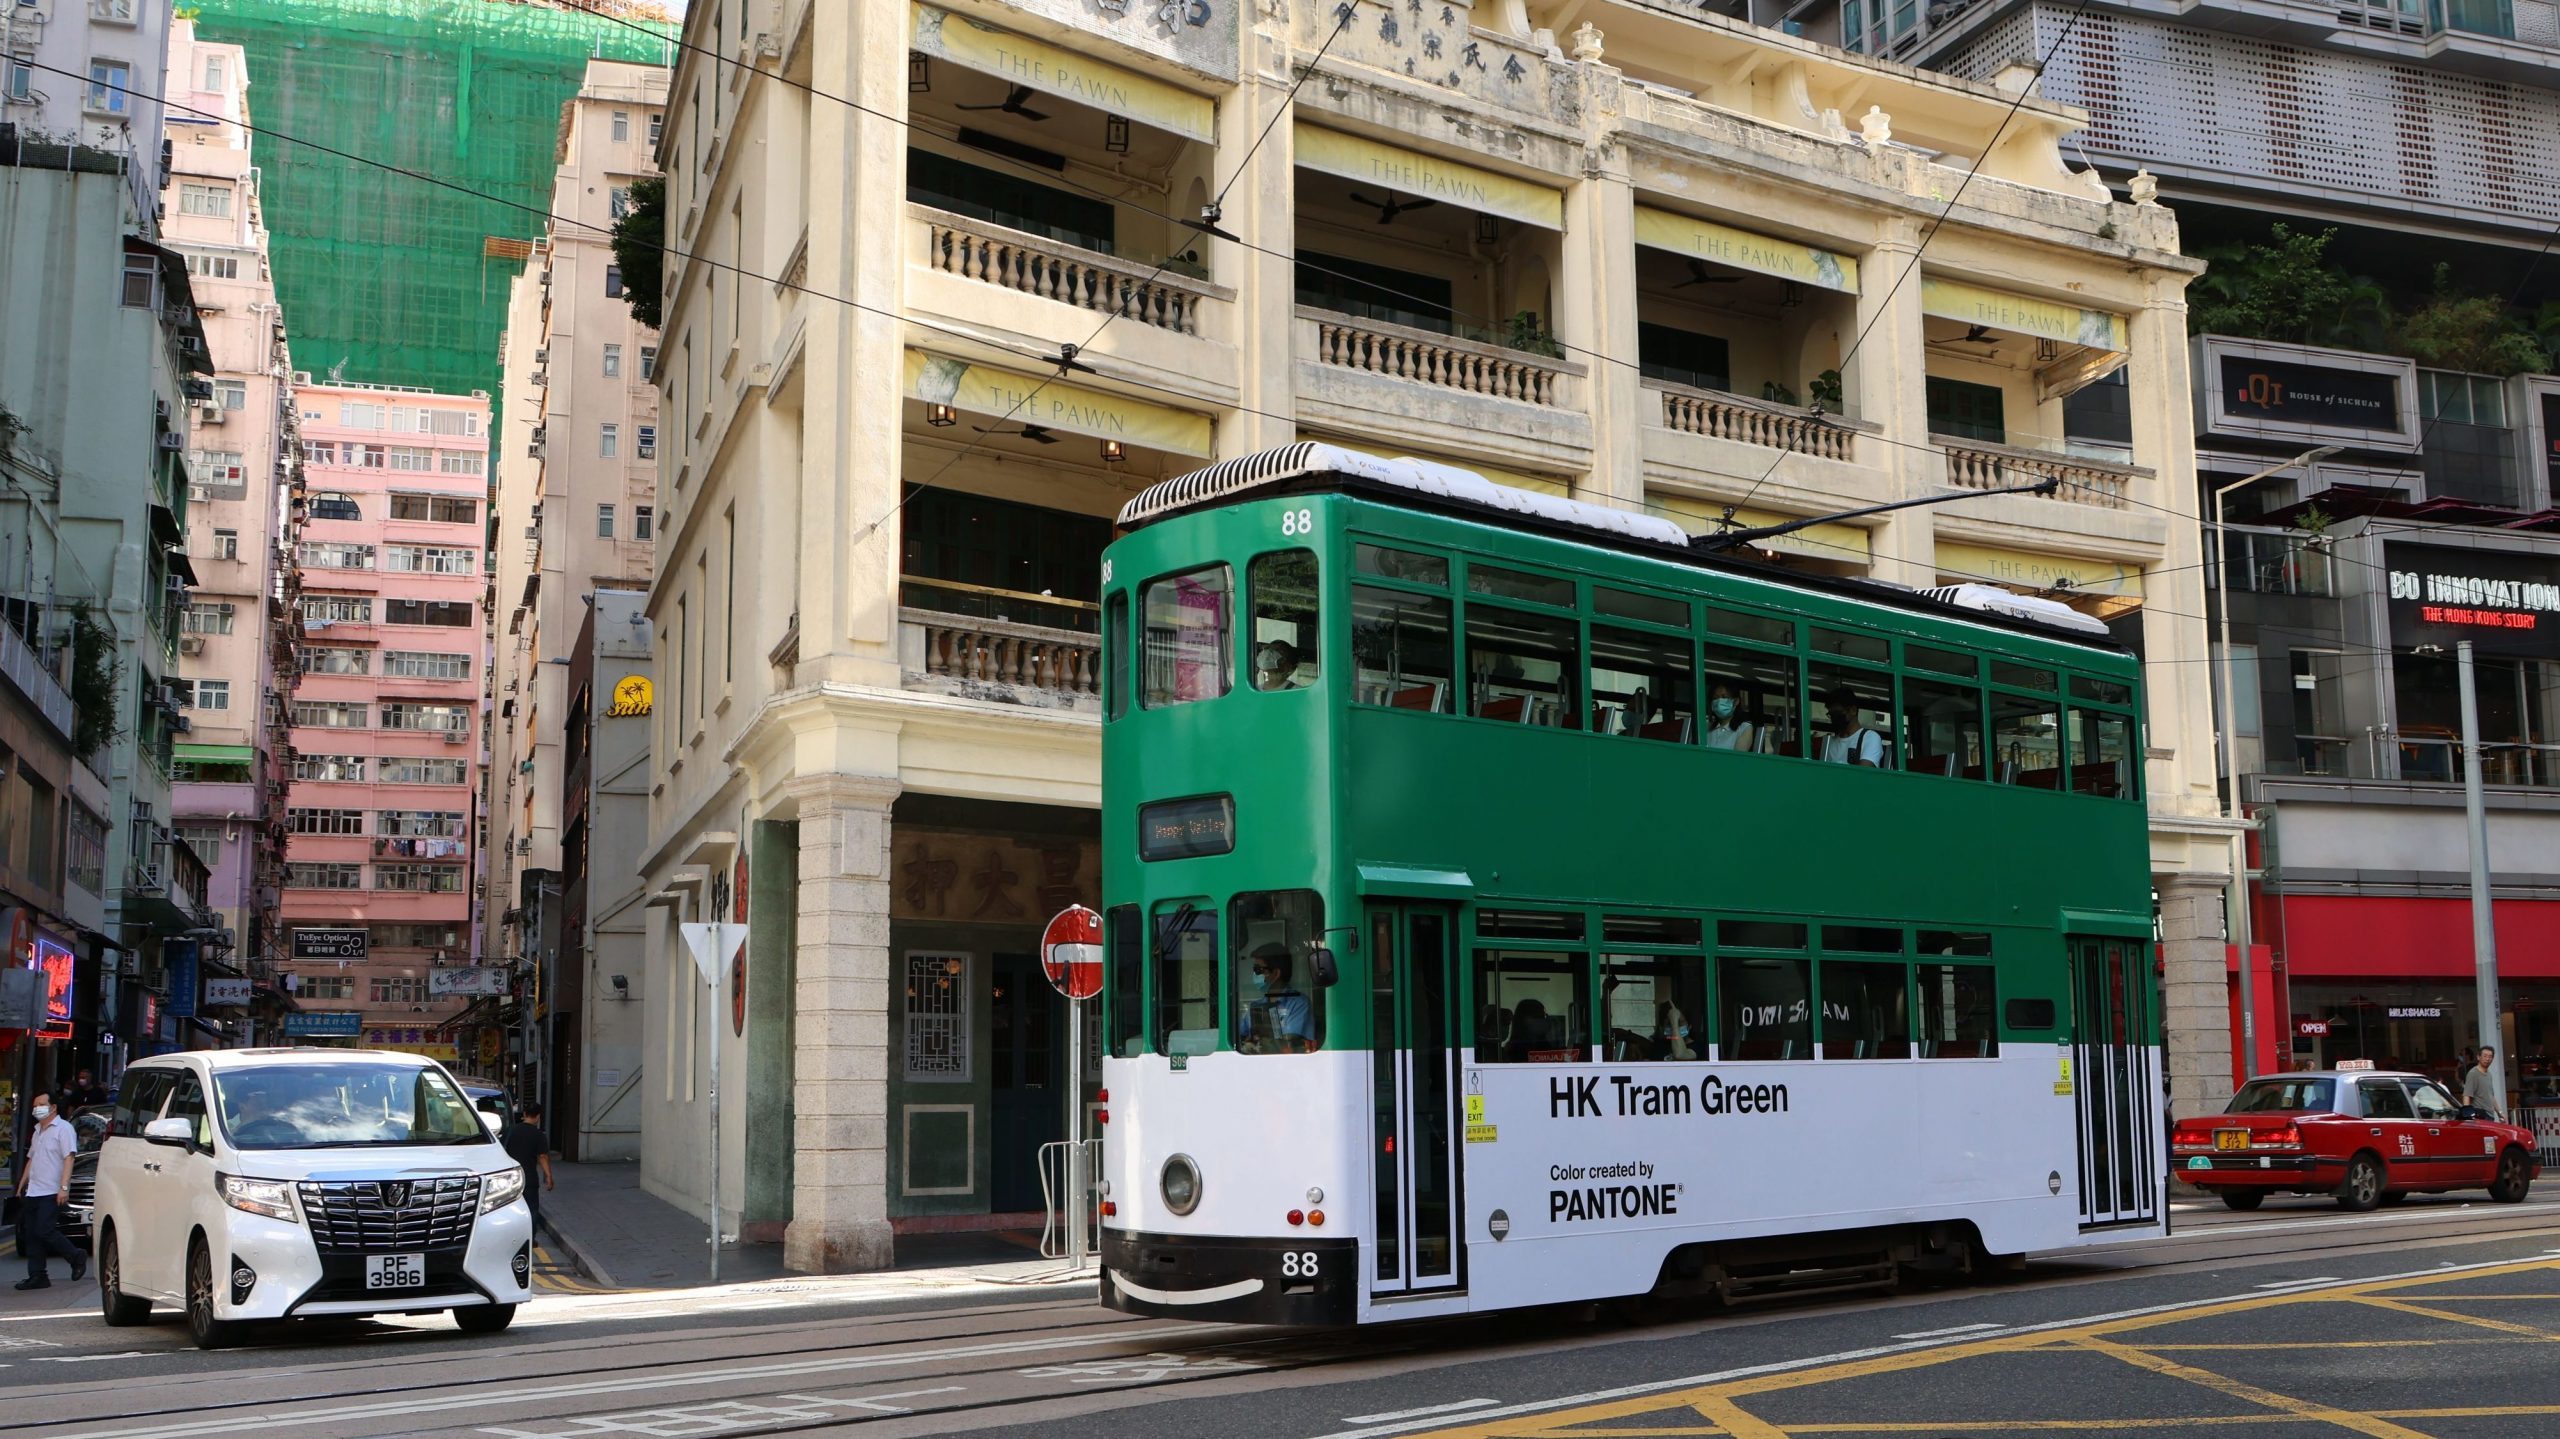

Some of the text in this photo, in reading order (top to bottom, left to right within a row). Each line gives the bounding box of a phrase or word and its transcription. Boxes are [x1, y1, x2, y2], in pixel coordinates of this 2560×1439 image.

[996, 48, 1127, 108] THE PAWN
[1371, 158, 1485, 204] THE PAWN
[1694, 234, 1794, 272] THE PAWN
[1976, 302, 2065, 334] THE PAWN
[990, 386, 1124, 432] THE PAWN
[2289, 391, 2321, 402] HOUSE
[2325, 394, 2335, 405] of
[2338, 397, 2381, 408] SICHUAN
[1282, 509, 1312, 536] 88
[1102, 559, 1113, 585] 88
[1987, 559, 2022, 578] THE
[2390, 570, 2560, 612] BO INNOVATION
[2422, 606, 2536, 629] THE HONG KONG STORY
[323, 933, 350, 943] Optical
[2388, 1008, 2440, 1017] MILKSHAKES
[2301, 1023, 2327, 1034] OPEN
[1550, 1074, 1789, 1118] HK Tram Green
[1467, 1113, 1482, 1121] EXIT
[2398, 1134, 2413, 1144] 的士
[2400, 1144, 2415, 1155] TAXI
[1550, 1160, 1654, 1181] Color created by
[384, 1256, 408, 1271] PF
[1282, 1251, 1319, 1277] 88
[370, 1270, 421, 1287] 3986
